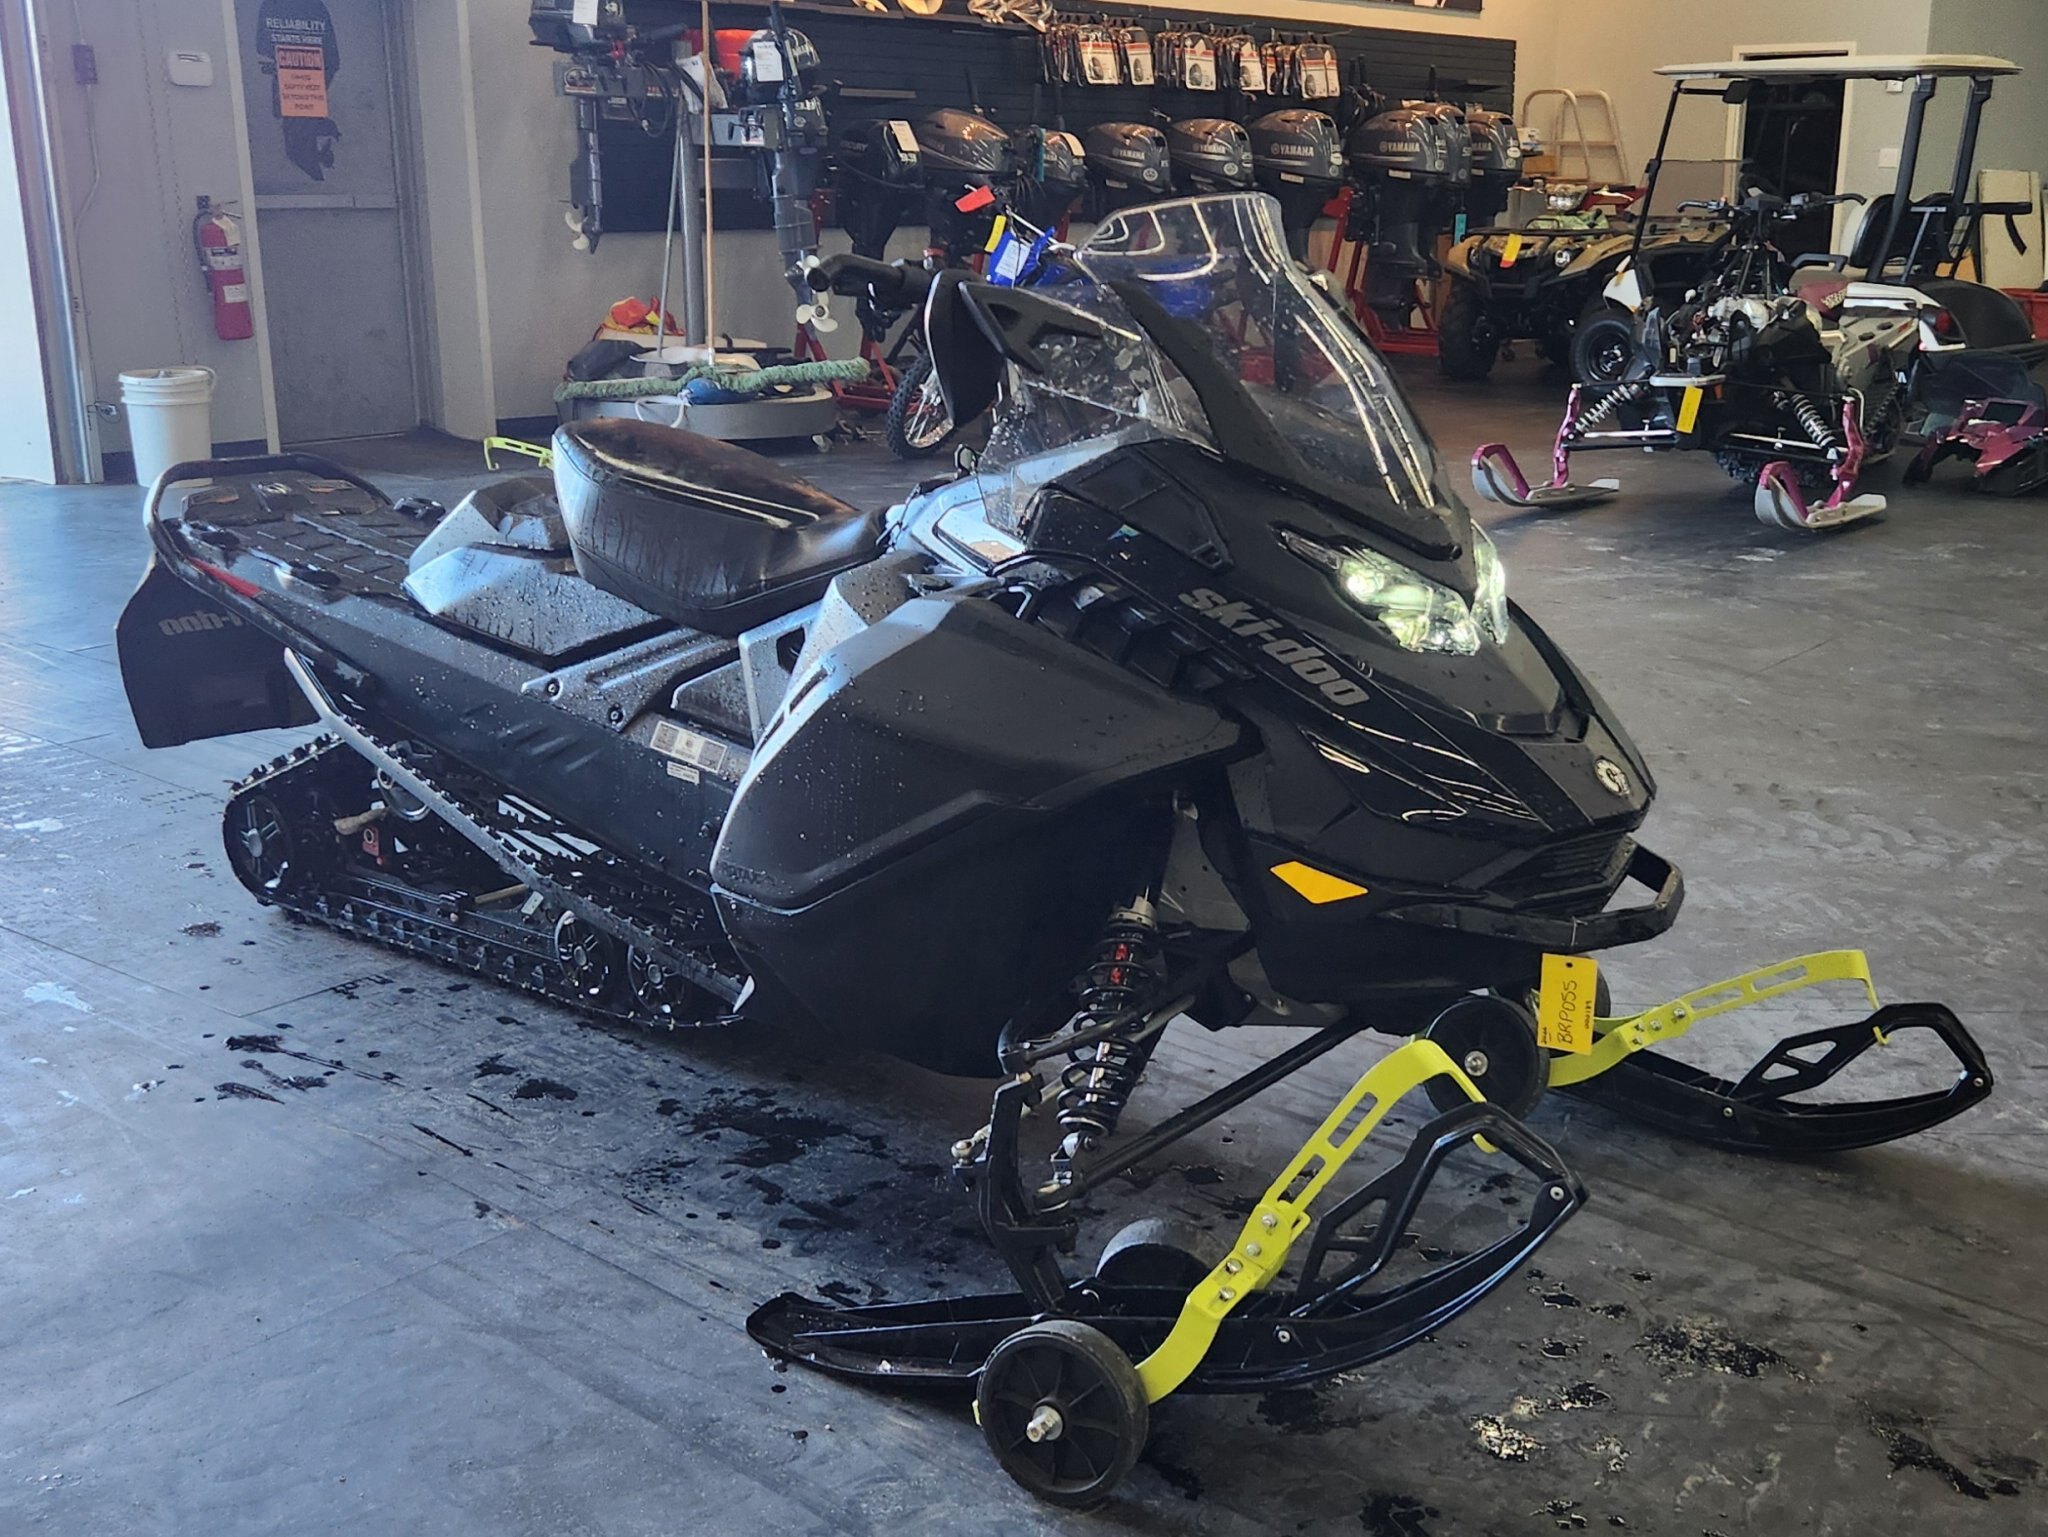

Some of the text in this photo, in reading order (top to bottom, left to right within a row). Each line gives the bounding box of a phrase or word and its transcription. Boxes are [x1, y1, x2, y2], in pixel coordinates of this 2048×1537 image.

[265, 17, 326, 31] RELIABILITY
[271, 33, 301, 44] STARTS
[278, 51, 322, 69] CAUTION
[1200, 143, 1226, 155] YAMAHA
[1280, 144, 1314, 157] YAMAHA
[1387, 141, 1421, 153] YAMAHA
[1119, 149, 1146, 160] YAMAHA
[1556, 980, 1578, 1045] BRP055
